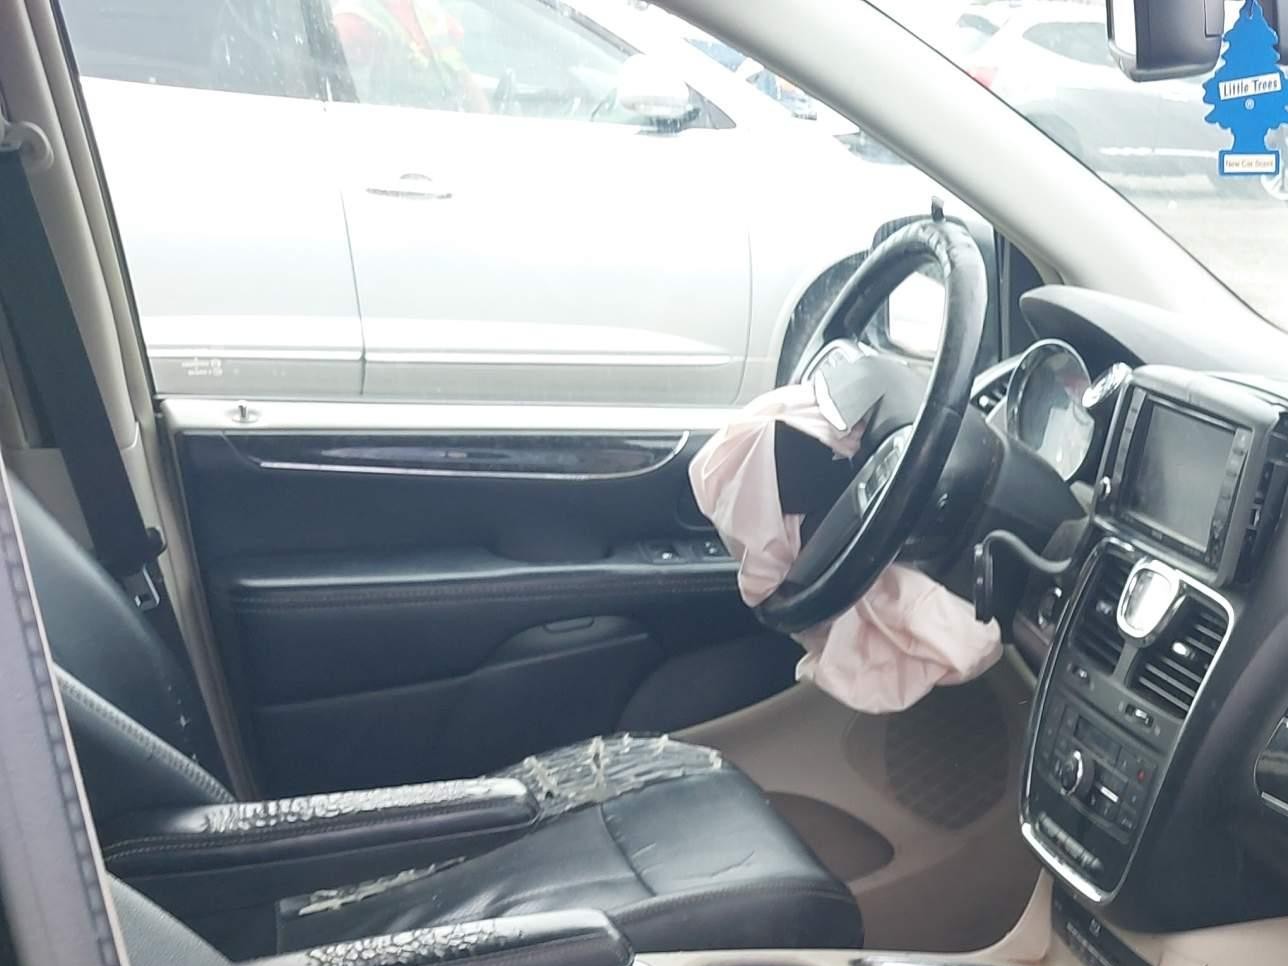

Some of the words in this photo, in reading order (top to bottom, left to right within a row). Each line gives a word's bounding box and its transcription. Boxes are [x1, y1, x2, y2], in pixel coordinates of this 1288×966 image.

[1223, 80, 1249, 97] Little
[1253, 78, 1278, 92] Trees
[1241, 159, 1253, 168] Car
